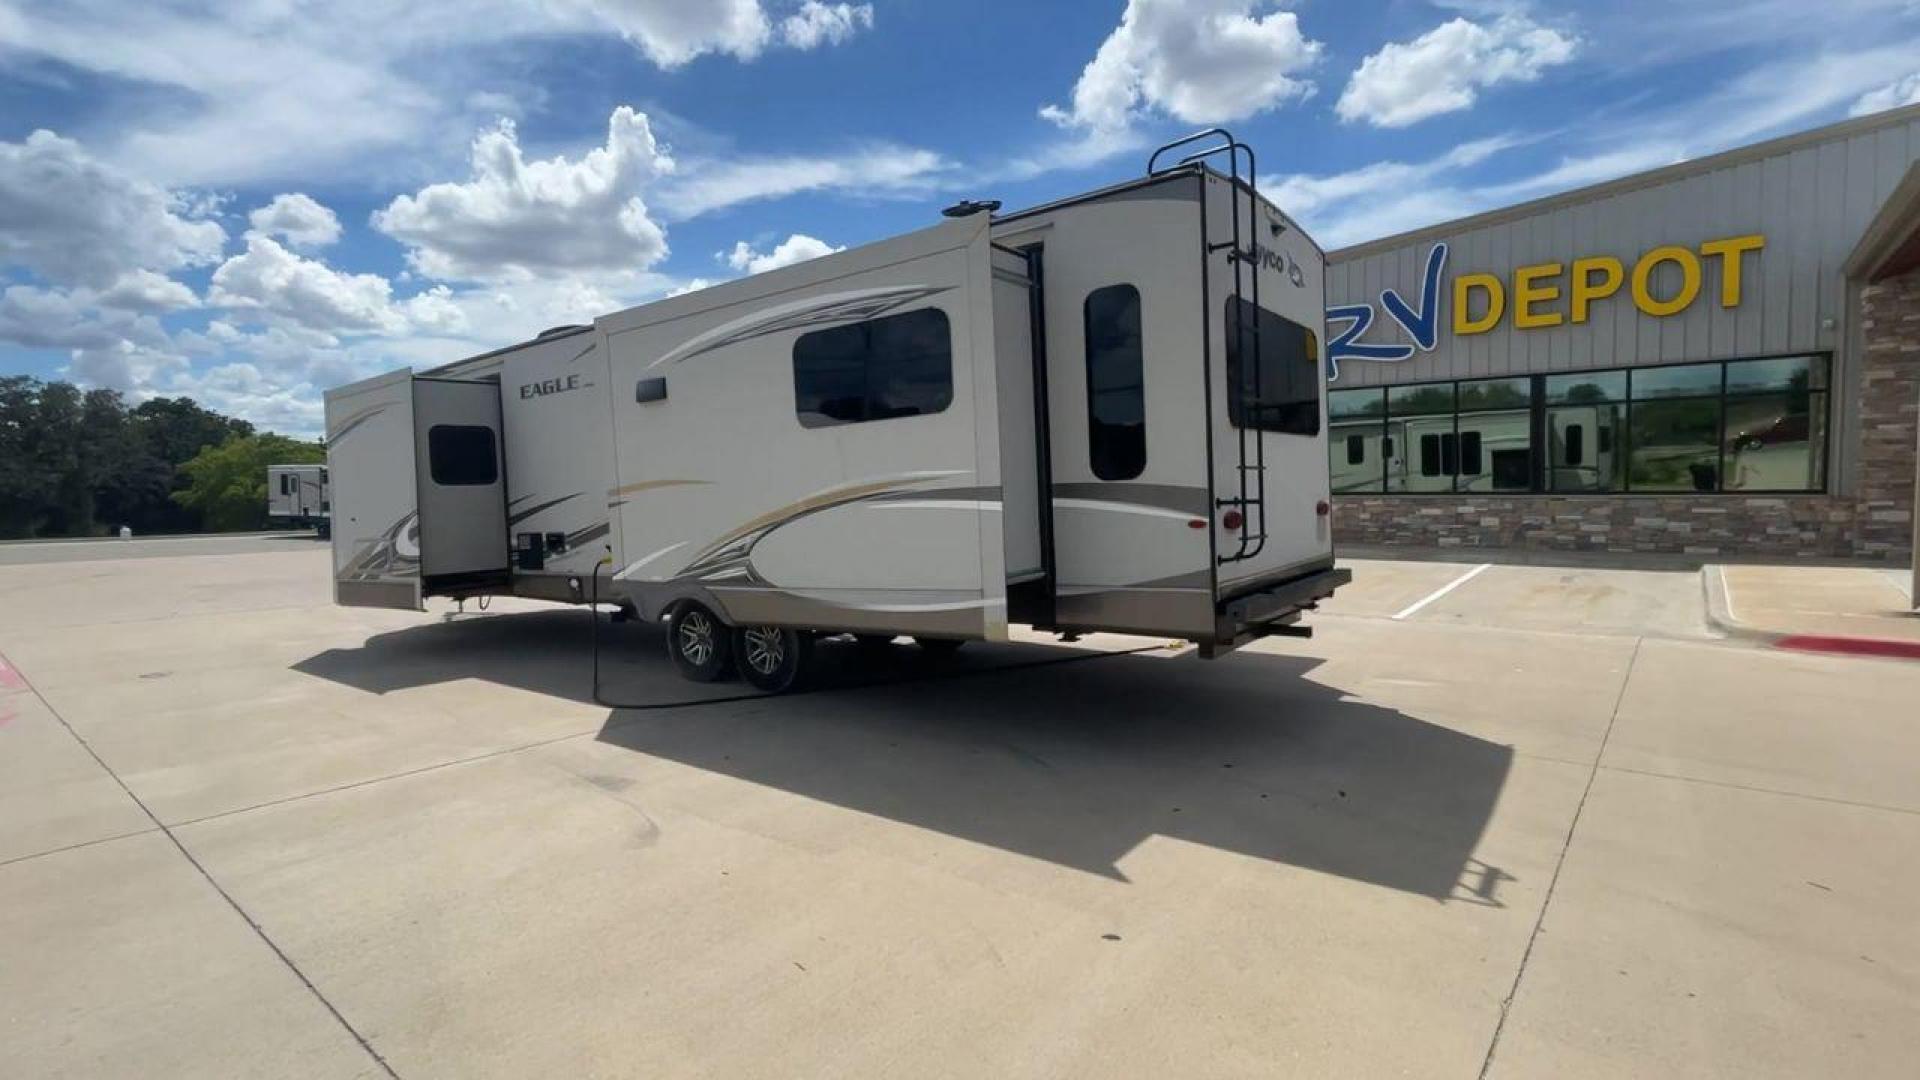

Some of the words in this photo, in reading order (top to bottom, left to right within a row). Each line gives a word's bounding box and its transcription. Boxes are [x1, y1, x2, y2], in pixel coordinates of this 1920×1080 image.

[1247, 243, 1284, 274] yco
[1327, 242, 1448, 382] RV
[1453, 235, 1765, 336] DEPOT
[520, 374, 580, 400] EAGLE
